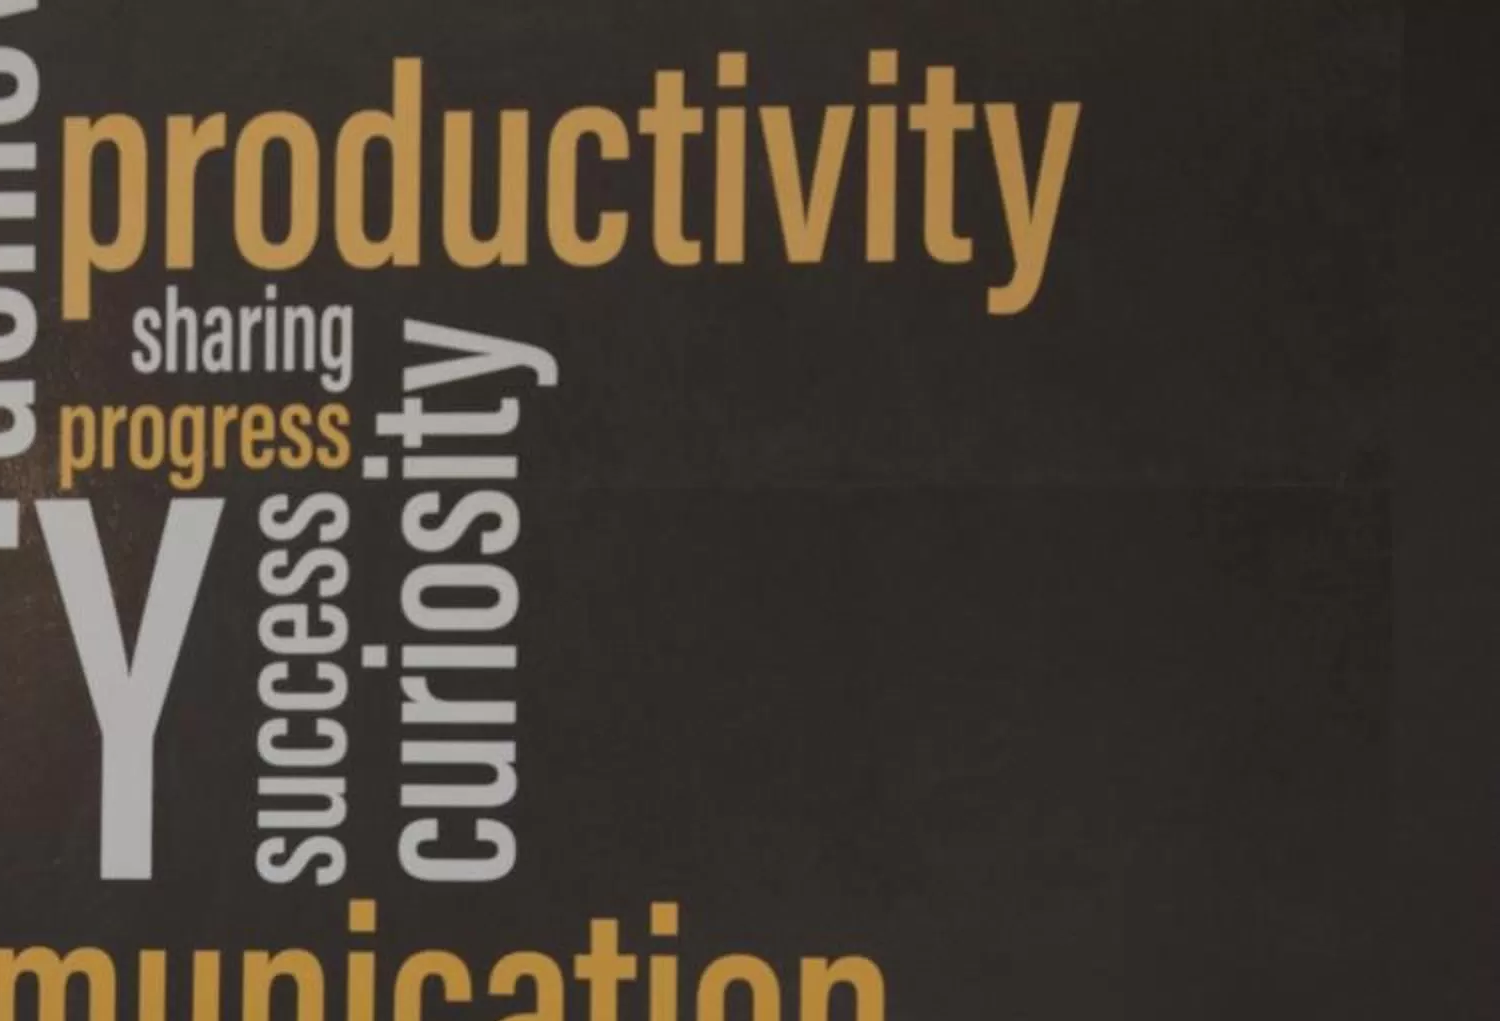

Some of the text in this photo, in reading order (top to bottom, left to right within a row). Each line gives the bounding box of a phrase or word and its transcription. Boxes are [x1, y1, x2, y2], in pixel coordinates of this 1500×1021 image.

[62, 49, 1080, 320] productivity
[58, 403, 352, 490] progress
[132, 284, 353, 392] sharing
[256, 492, 350, 885] success
[362, 319, 558, 882] curiosity
